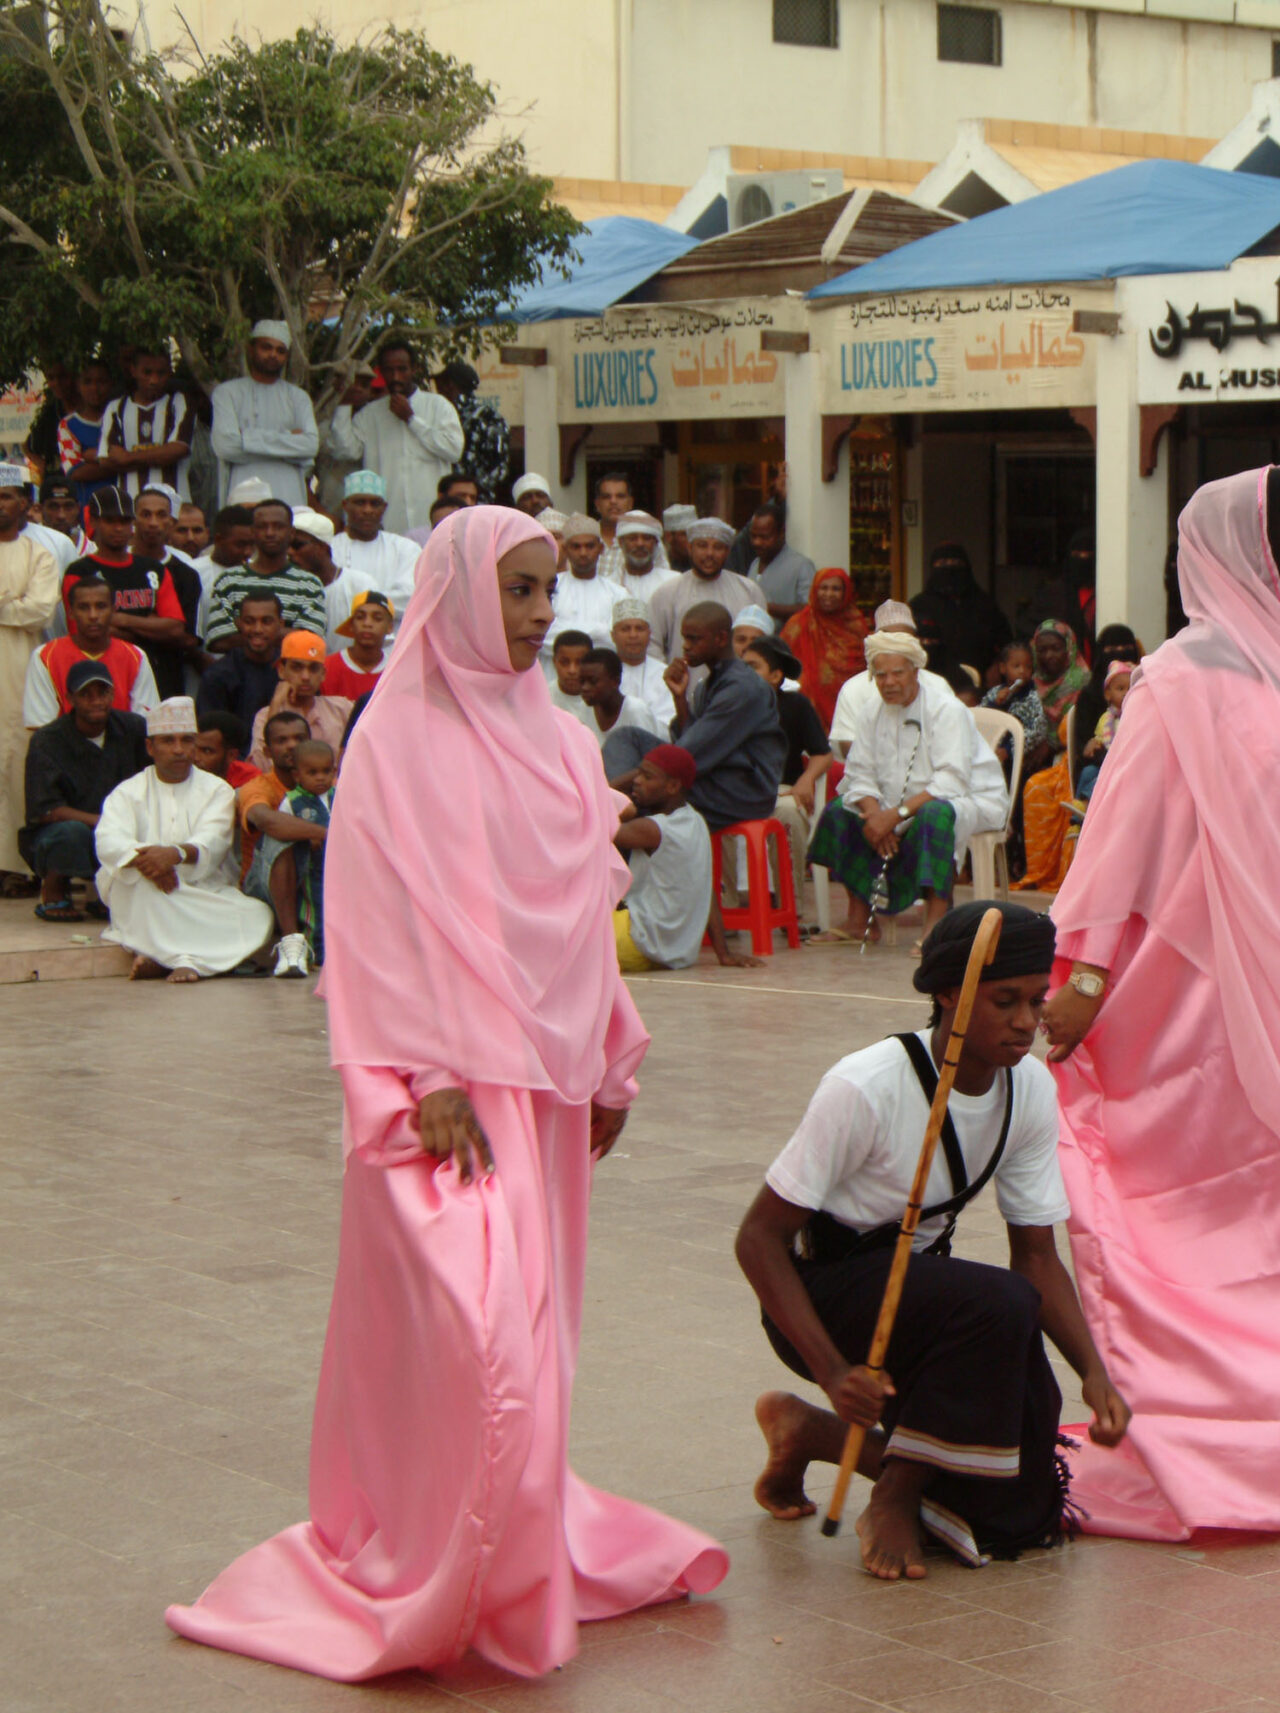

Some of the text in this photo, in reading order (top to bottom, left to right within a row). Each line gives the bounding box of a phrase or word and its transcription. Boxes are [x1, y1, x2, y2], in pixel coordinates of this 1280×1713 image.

[734, 307, 773, 327] محلات
[1016, 289, 1071, 311] محلات
[840, 337, 938, 390] LUXURIES
[964, 319, 1085, 384] كماليات
[574, 348, 658, 409] LUXURIES
[1178, 371, 1211, 390] AL
